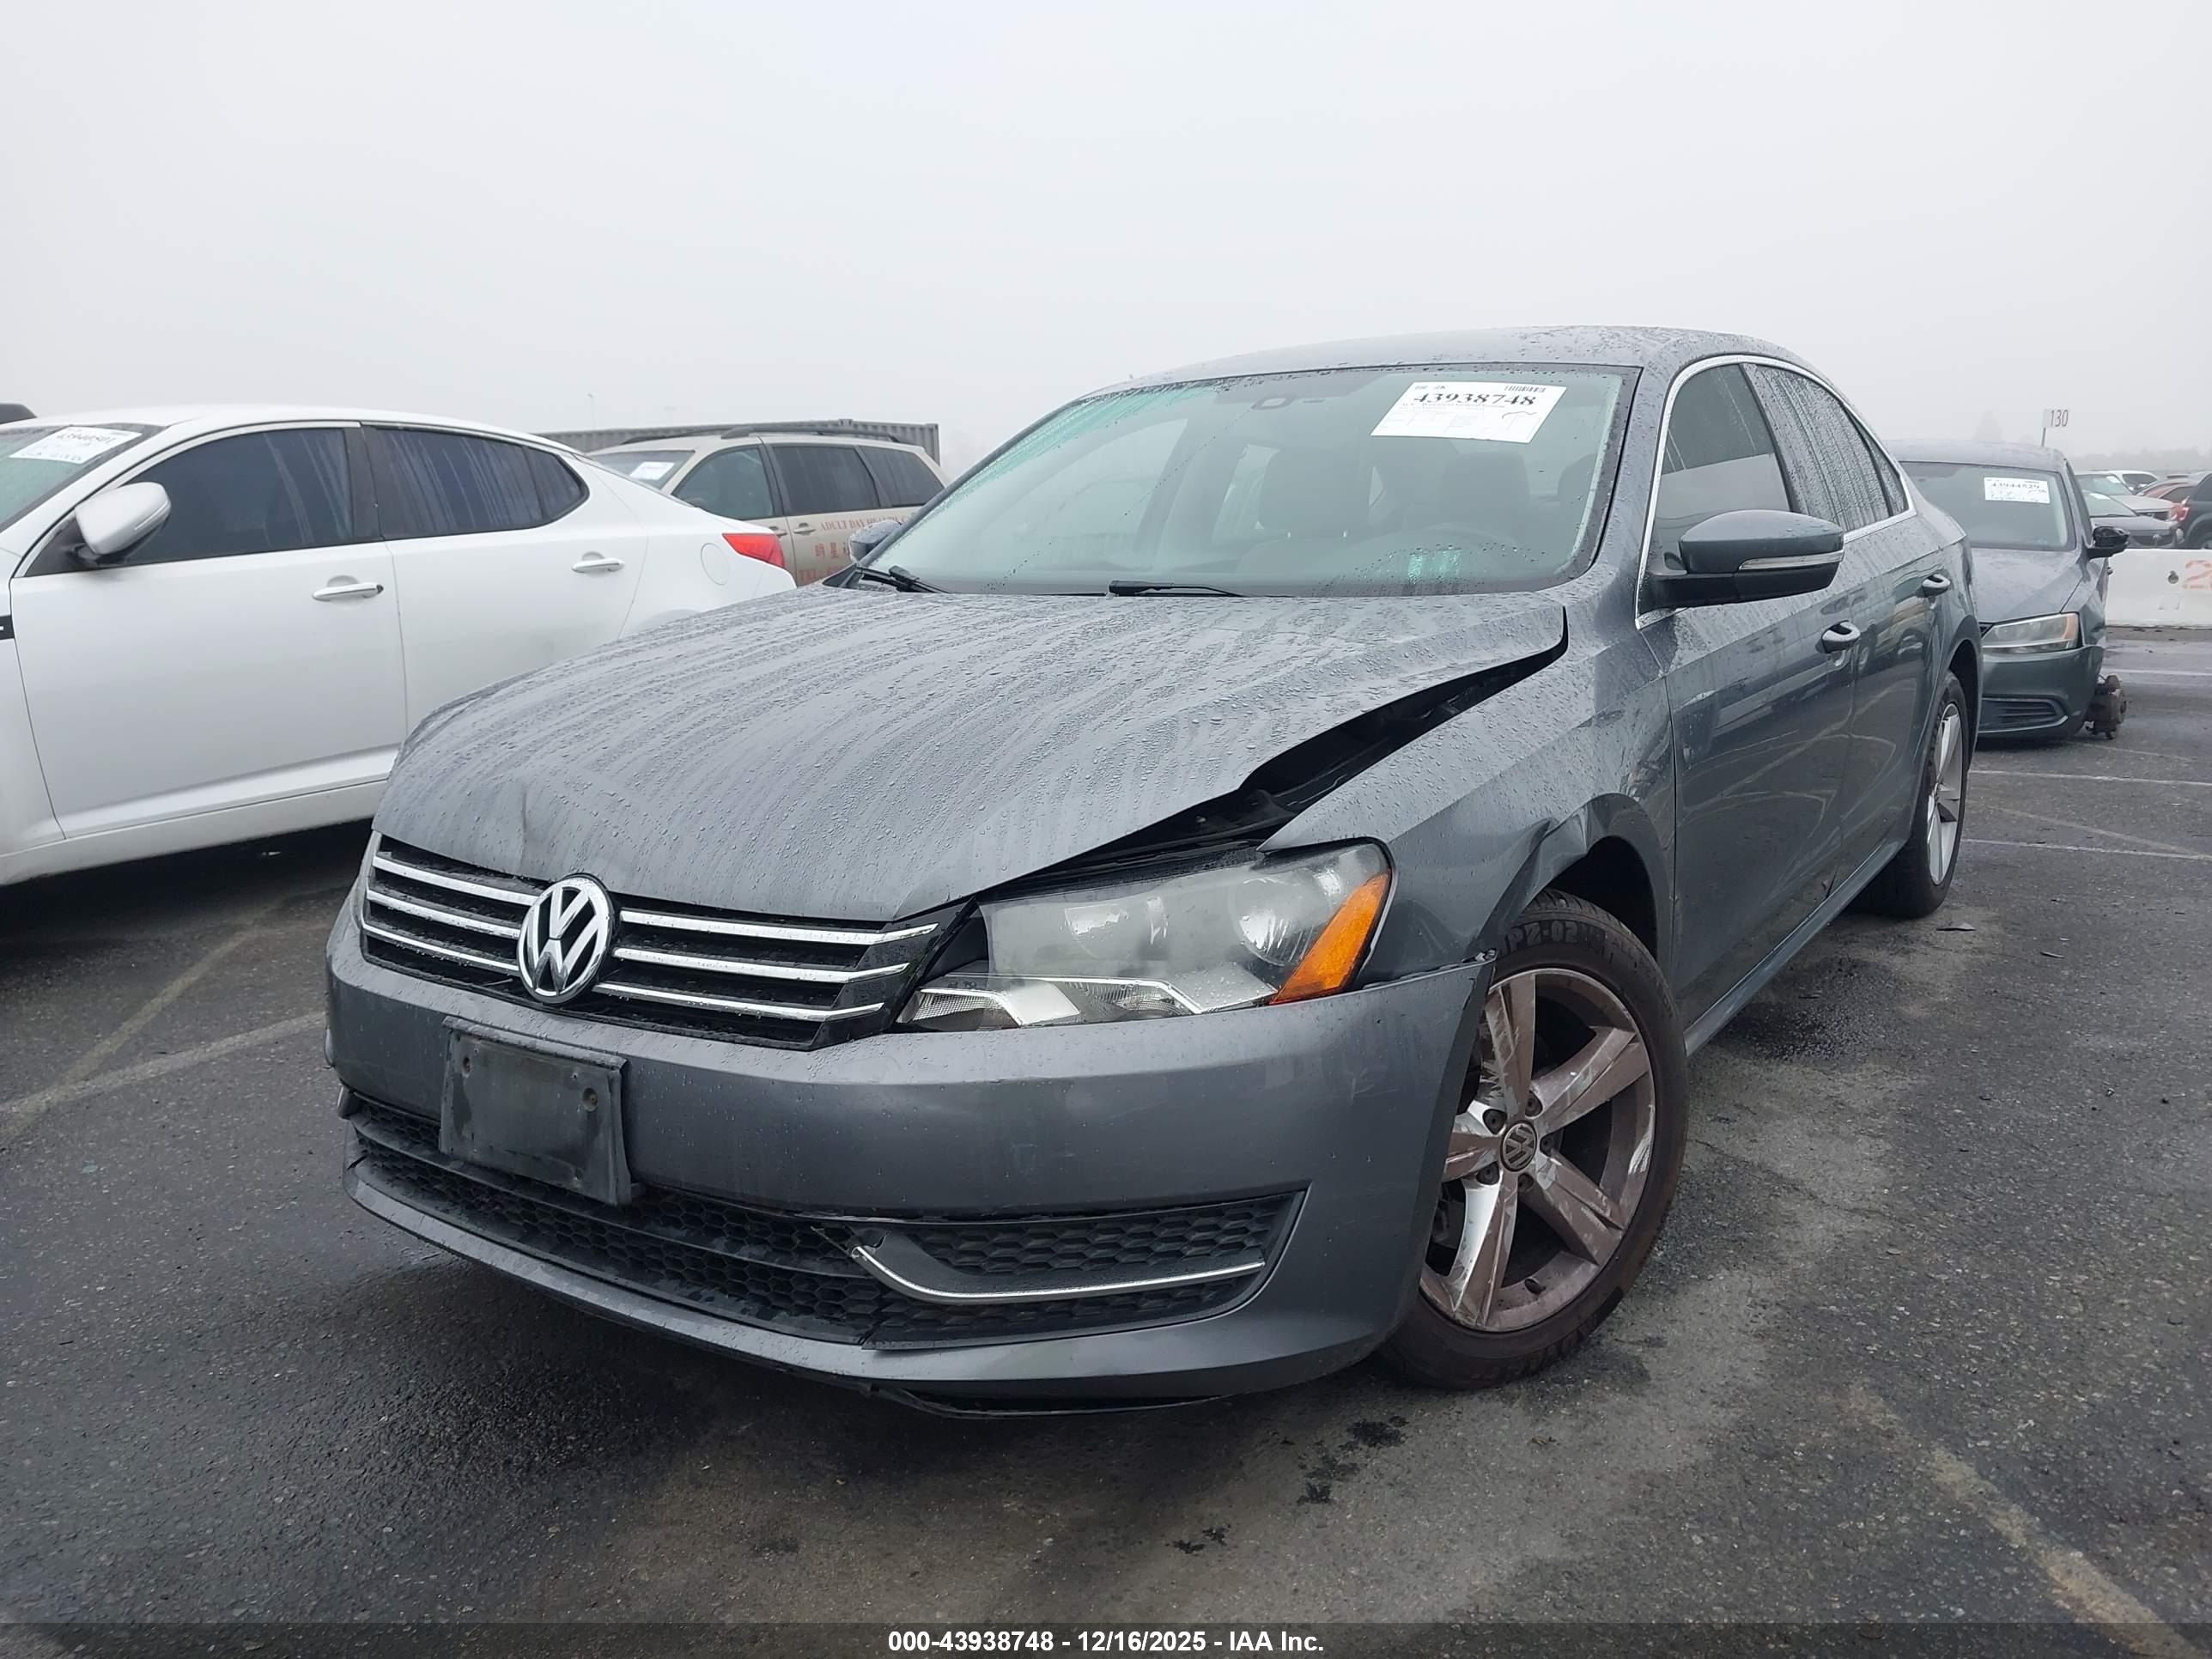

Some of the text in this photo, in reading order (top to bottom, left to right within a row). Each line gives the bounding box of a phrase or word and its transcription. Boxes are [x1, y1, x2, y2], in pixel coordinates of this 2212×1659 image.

[1413, 392, 1536, 406] 43938748
[2051, 409, 2069, 427] 130
[820, 521, 848, 531] ADULT
